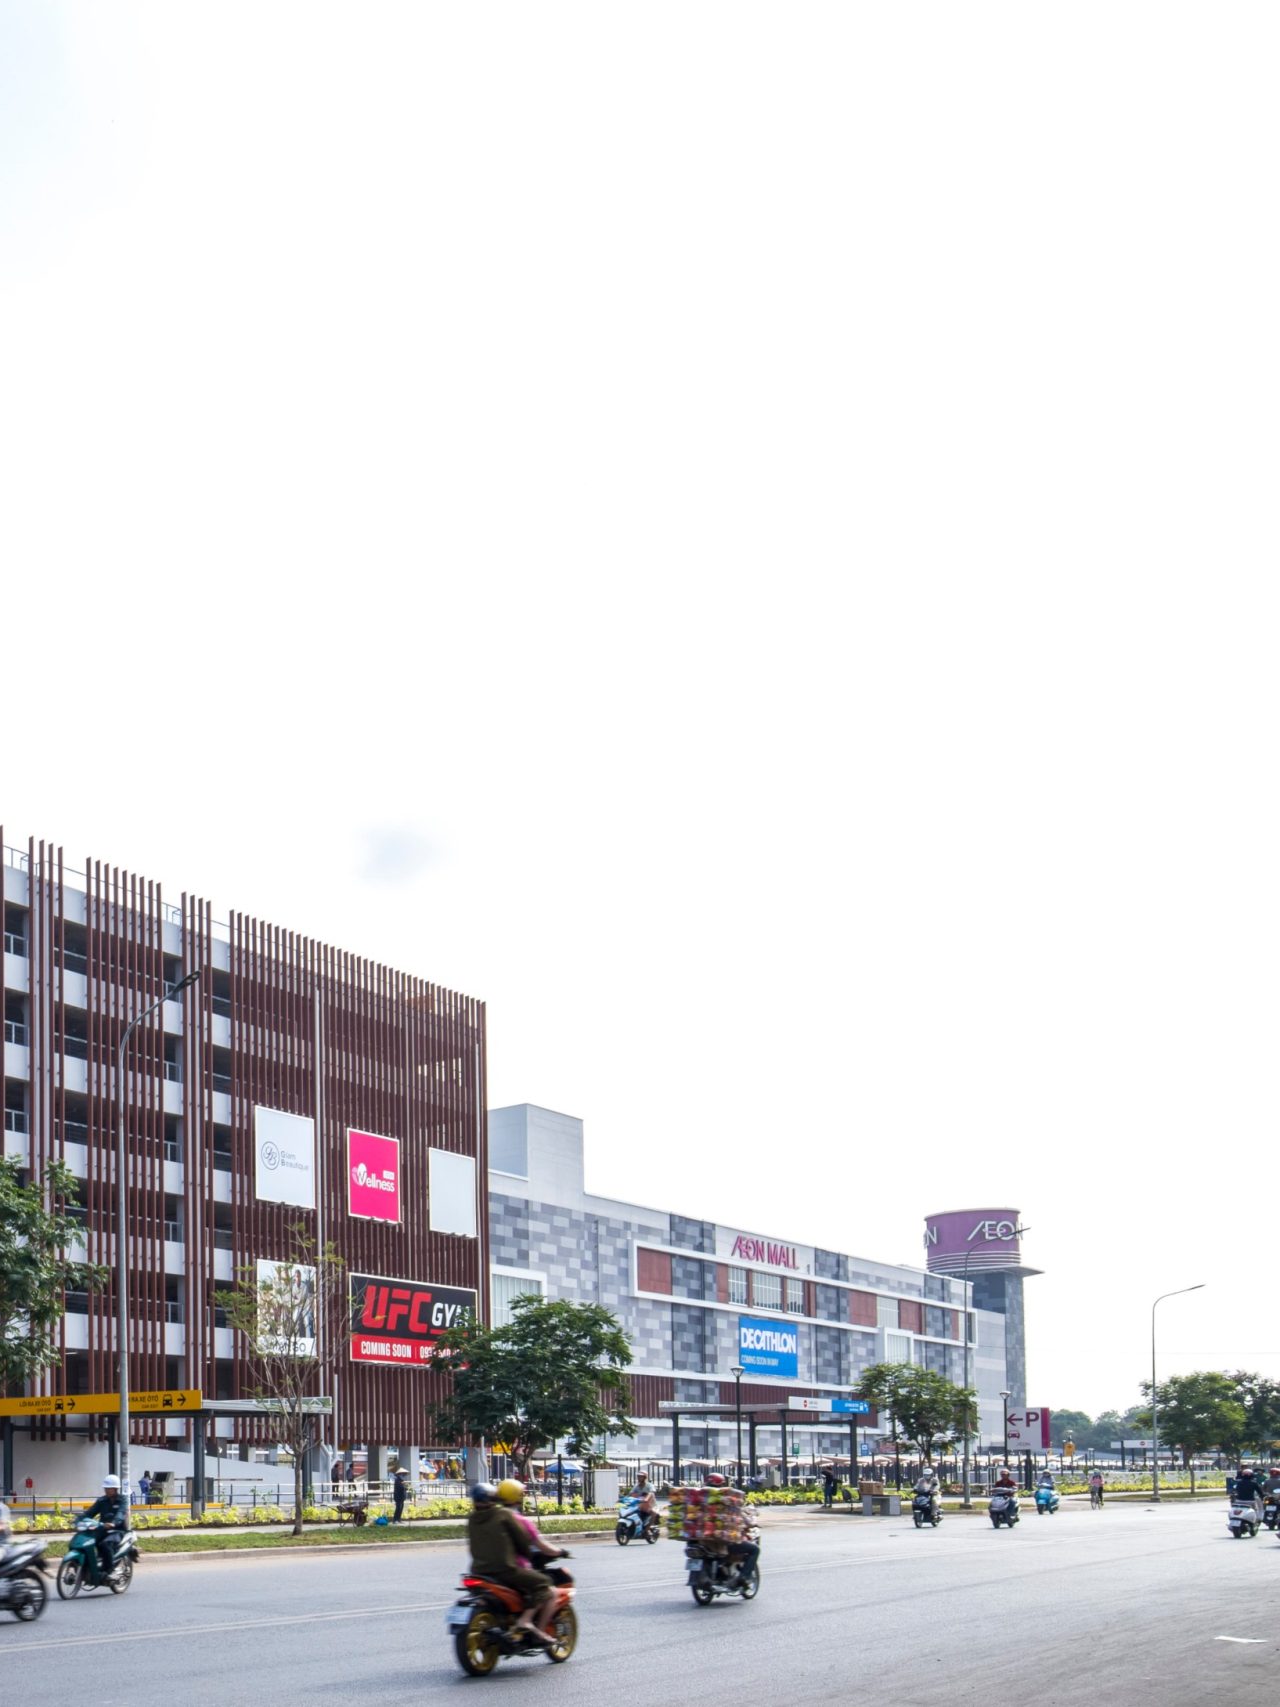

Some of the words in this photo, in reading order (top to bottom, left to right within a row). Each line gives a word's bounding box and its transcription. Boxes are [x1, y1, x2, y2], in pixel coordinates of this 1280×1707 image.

[352, 1168, 395, 1192] Wellness
[766, 1242, 797, 1270] MALL
[362, 1285, 432, 1334] UFC
[361, 1341, 391, 1356] COMING
[392, 1343, 412, 1358] SOON
[740, 1327, 797, 1354] DECATHLON
[1026, 1411, 1039, 1427] P
